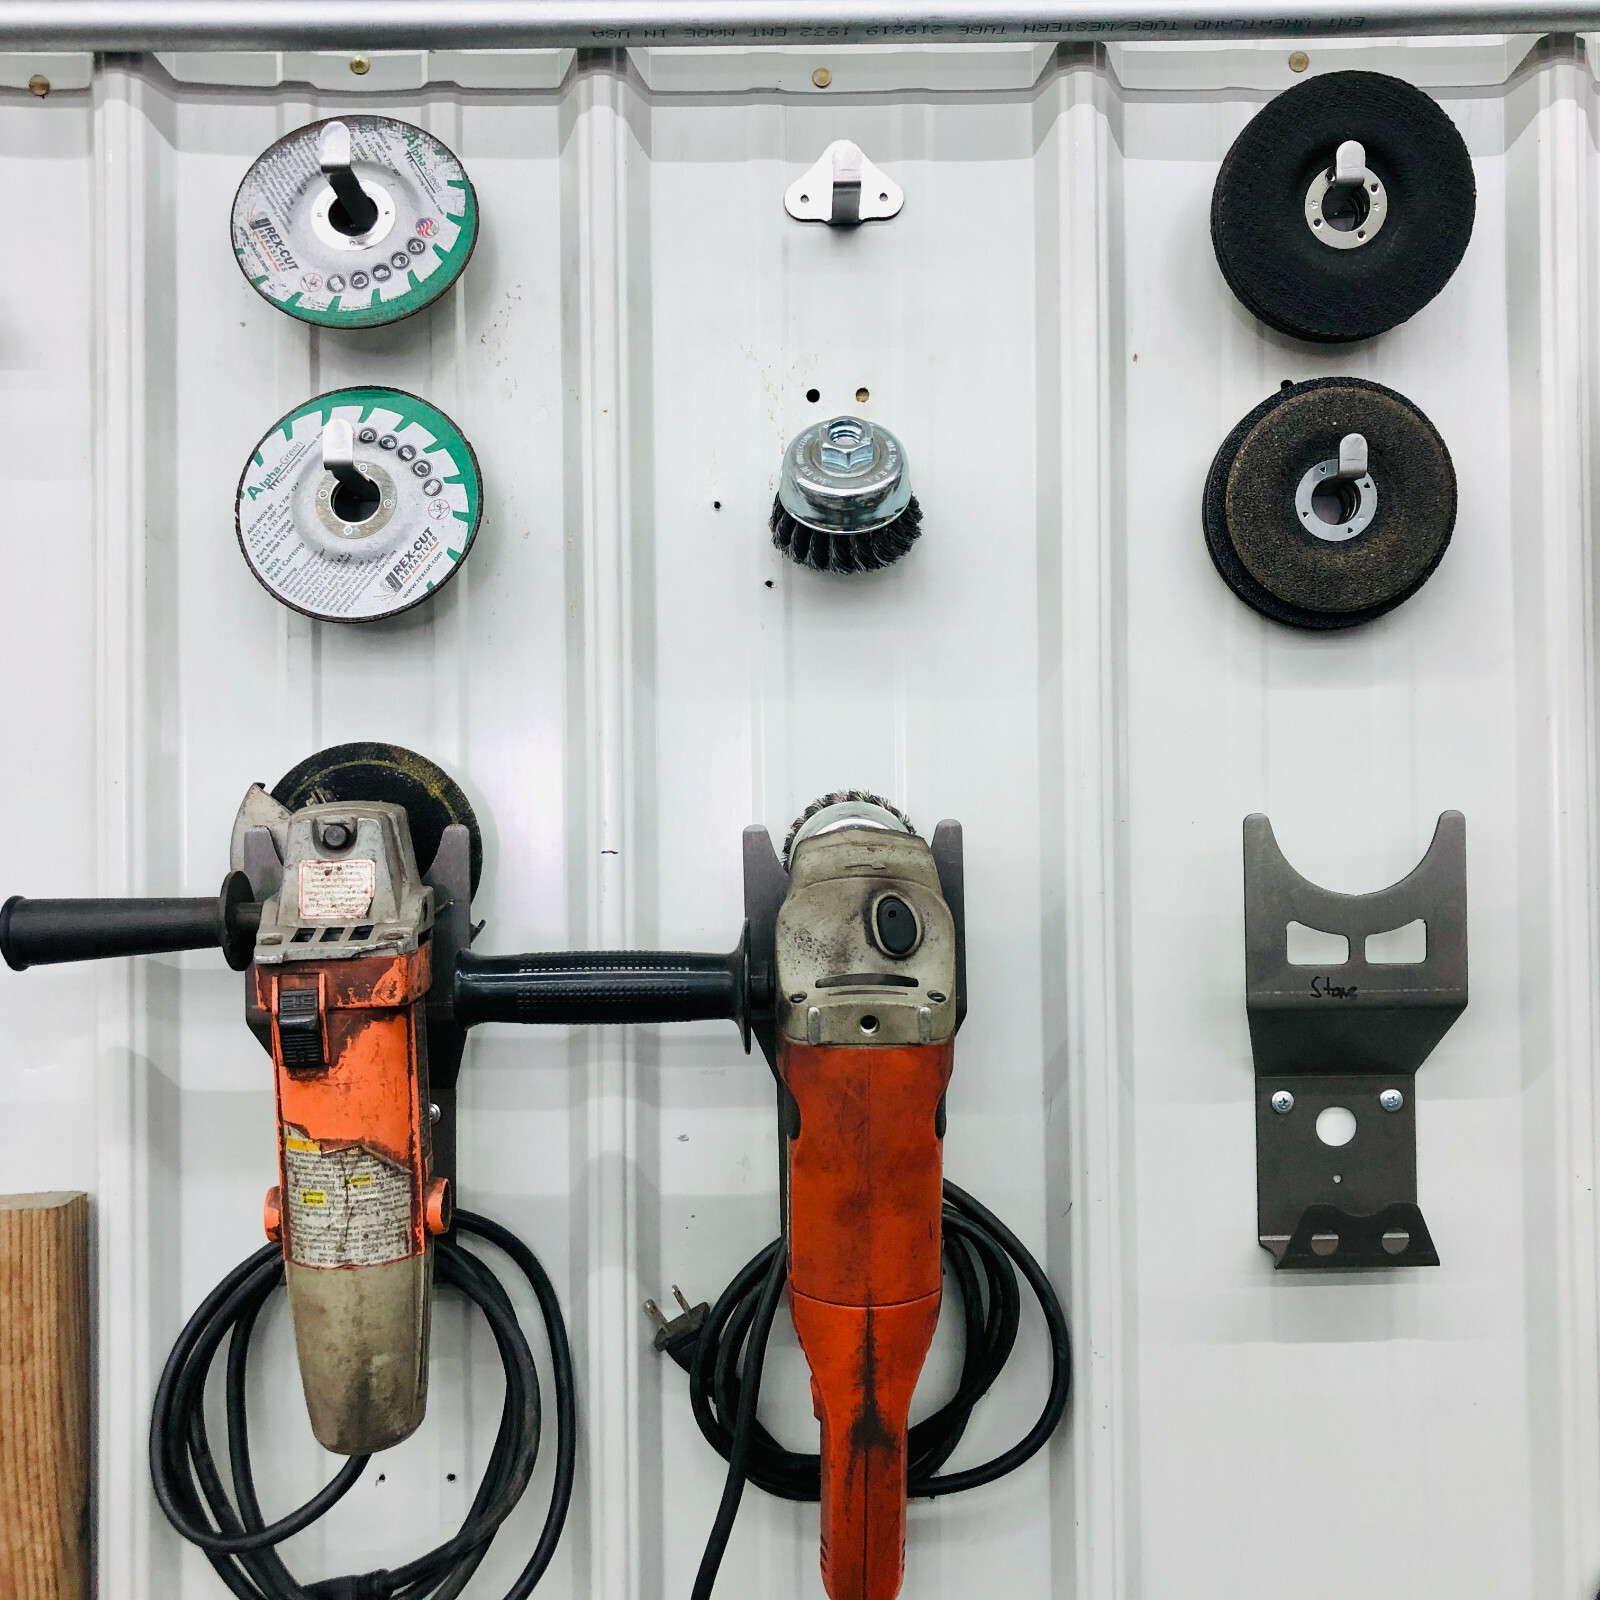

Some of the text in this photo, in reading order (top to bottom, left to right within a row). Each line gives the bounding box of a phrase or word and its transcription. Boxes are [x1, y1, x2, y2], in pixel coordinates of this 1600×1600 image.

[1023, 21, 1178, 34] TUBE/WESTERN
[1193, 18, 1311, 31] WHEATLAND
[1324, 16, 1365, 28] EMT
[590, 28, 630, 39] USA
[643, 28, 667, 39] IN
[682, 27, 735, 39] MADE
[747, 27, 787, 38] EMT
[799, 26, 850, 38] 1932
[956, 25, 1007, 36] TUBE
[257, 229, 287, 272] ABRASIVES
[264, 224, 299, 270] REX-CUT
[286, 457, 301, 473] Cutting
[299, 439, 317, 458] Stainless
[247, 439, 303, 501] Alpha-Green
[255, 546, 266, 559] Part
[259, 552, 270, 565] Max
[268, 540, 280, 554] RPM
[393, 526, 433, 575] REX-CUT
[399, 534, 437, 581] ABRASIVES
[264, 555, 280, 574] INOX
[270, 541, 304, 581] Fast Cutting
[402, 550, 443, 599] www.rexcut.com
